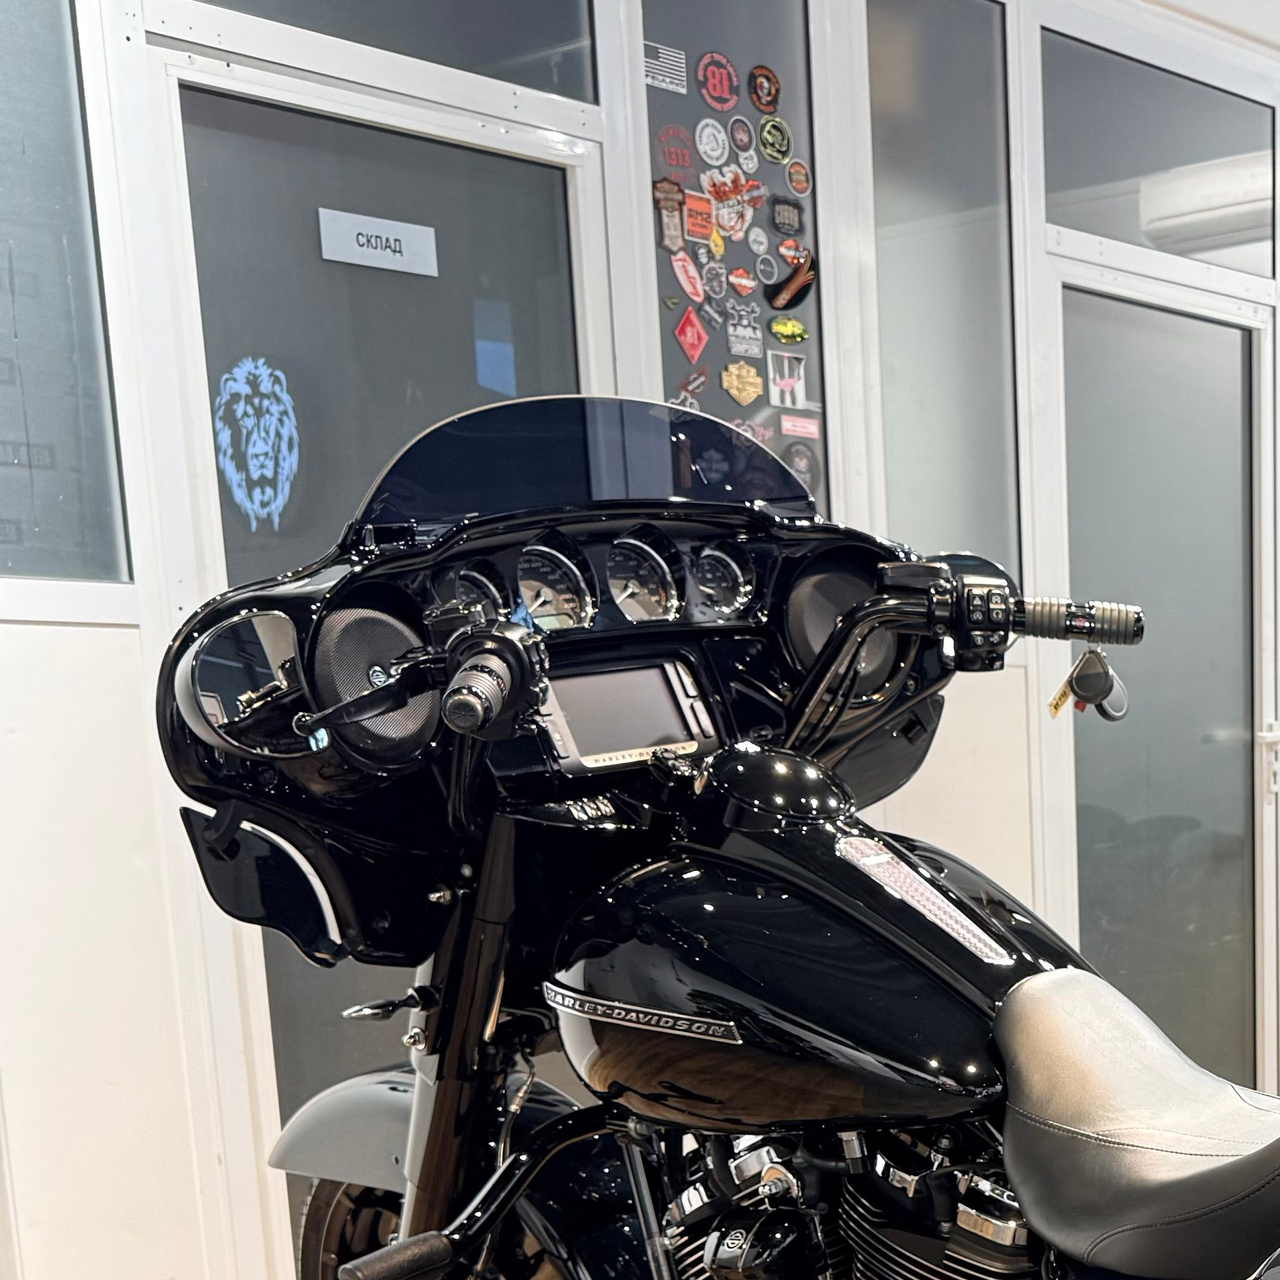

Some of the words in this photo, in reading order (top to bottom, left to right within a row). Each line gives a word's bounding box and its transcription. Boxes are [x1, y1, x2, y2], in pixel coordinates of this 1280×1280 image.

[706, 65, 731, 98] 81
[664, 147, 691, 167] 1313
[355, 231, 403, 257] СКЛАД
[594, 746, 687, 763] HARLEY-DAON
[547, 988, 728, 1036] HARLEY-DAVIDSON
